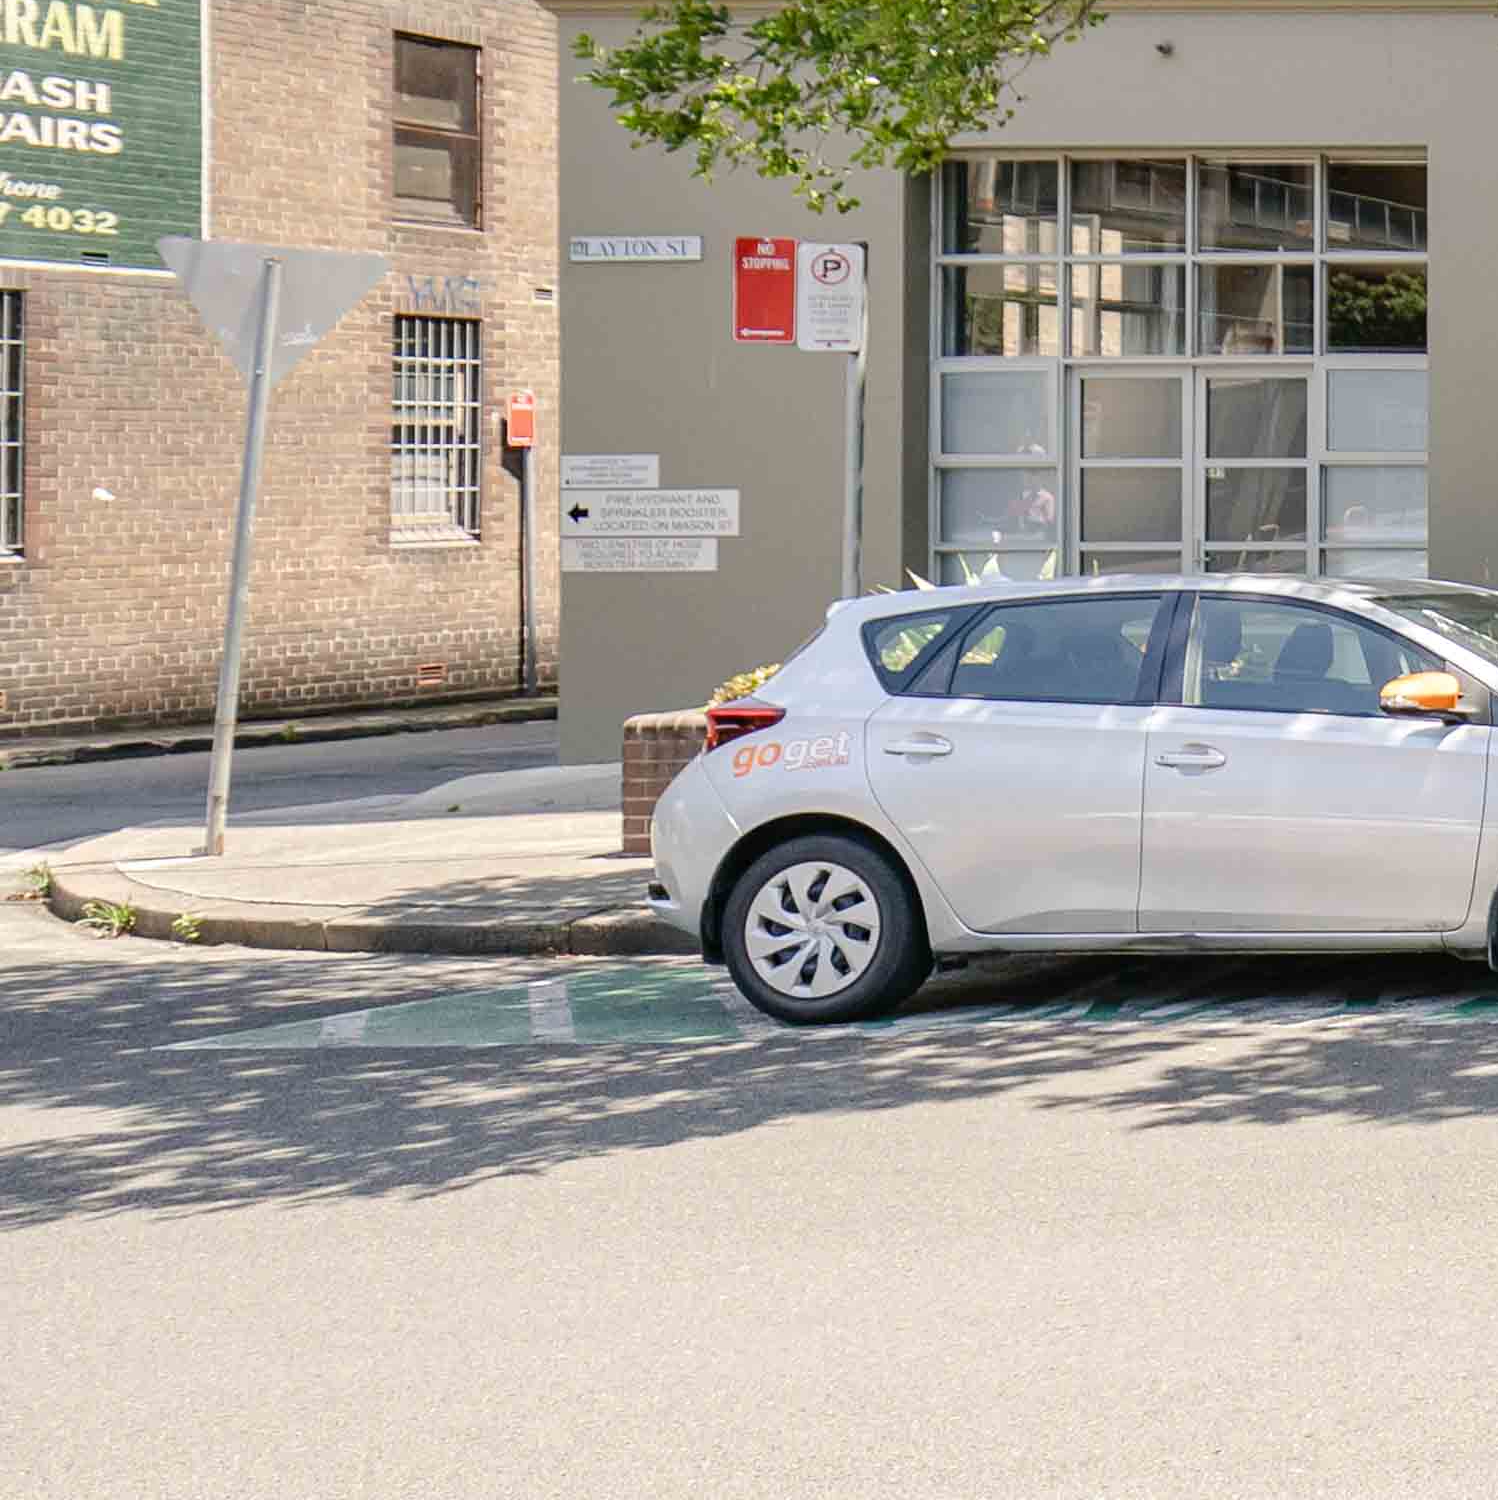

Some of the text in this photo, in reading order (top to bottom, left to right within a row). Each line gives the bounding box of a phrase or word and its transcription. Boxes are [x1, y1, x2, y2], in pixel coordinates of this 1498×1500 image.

[0, 70, 112, 114] ASH
[0, 112, 123, 154] AIRS
[21, 204, 119, 235] 4032
[741, 257, 792, 270] STOPPING
[756, 243, 776, 256] NO
[733, 732, 850, 778] goget
